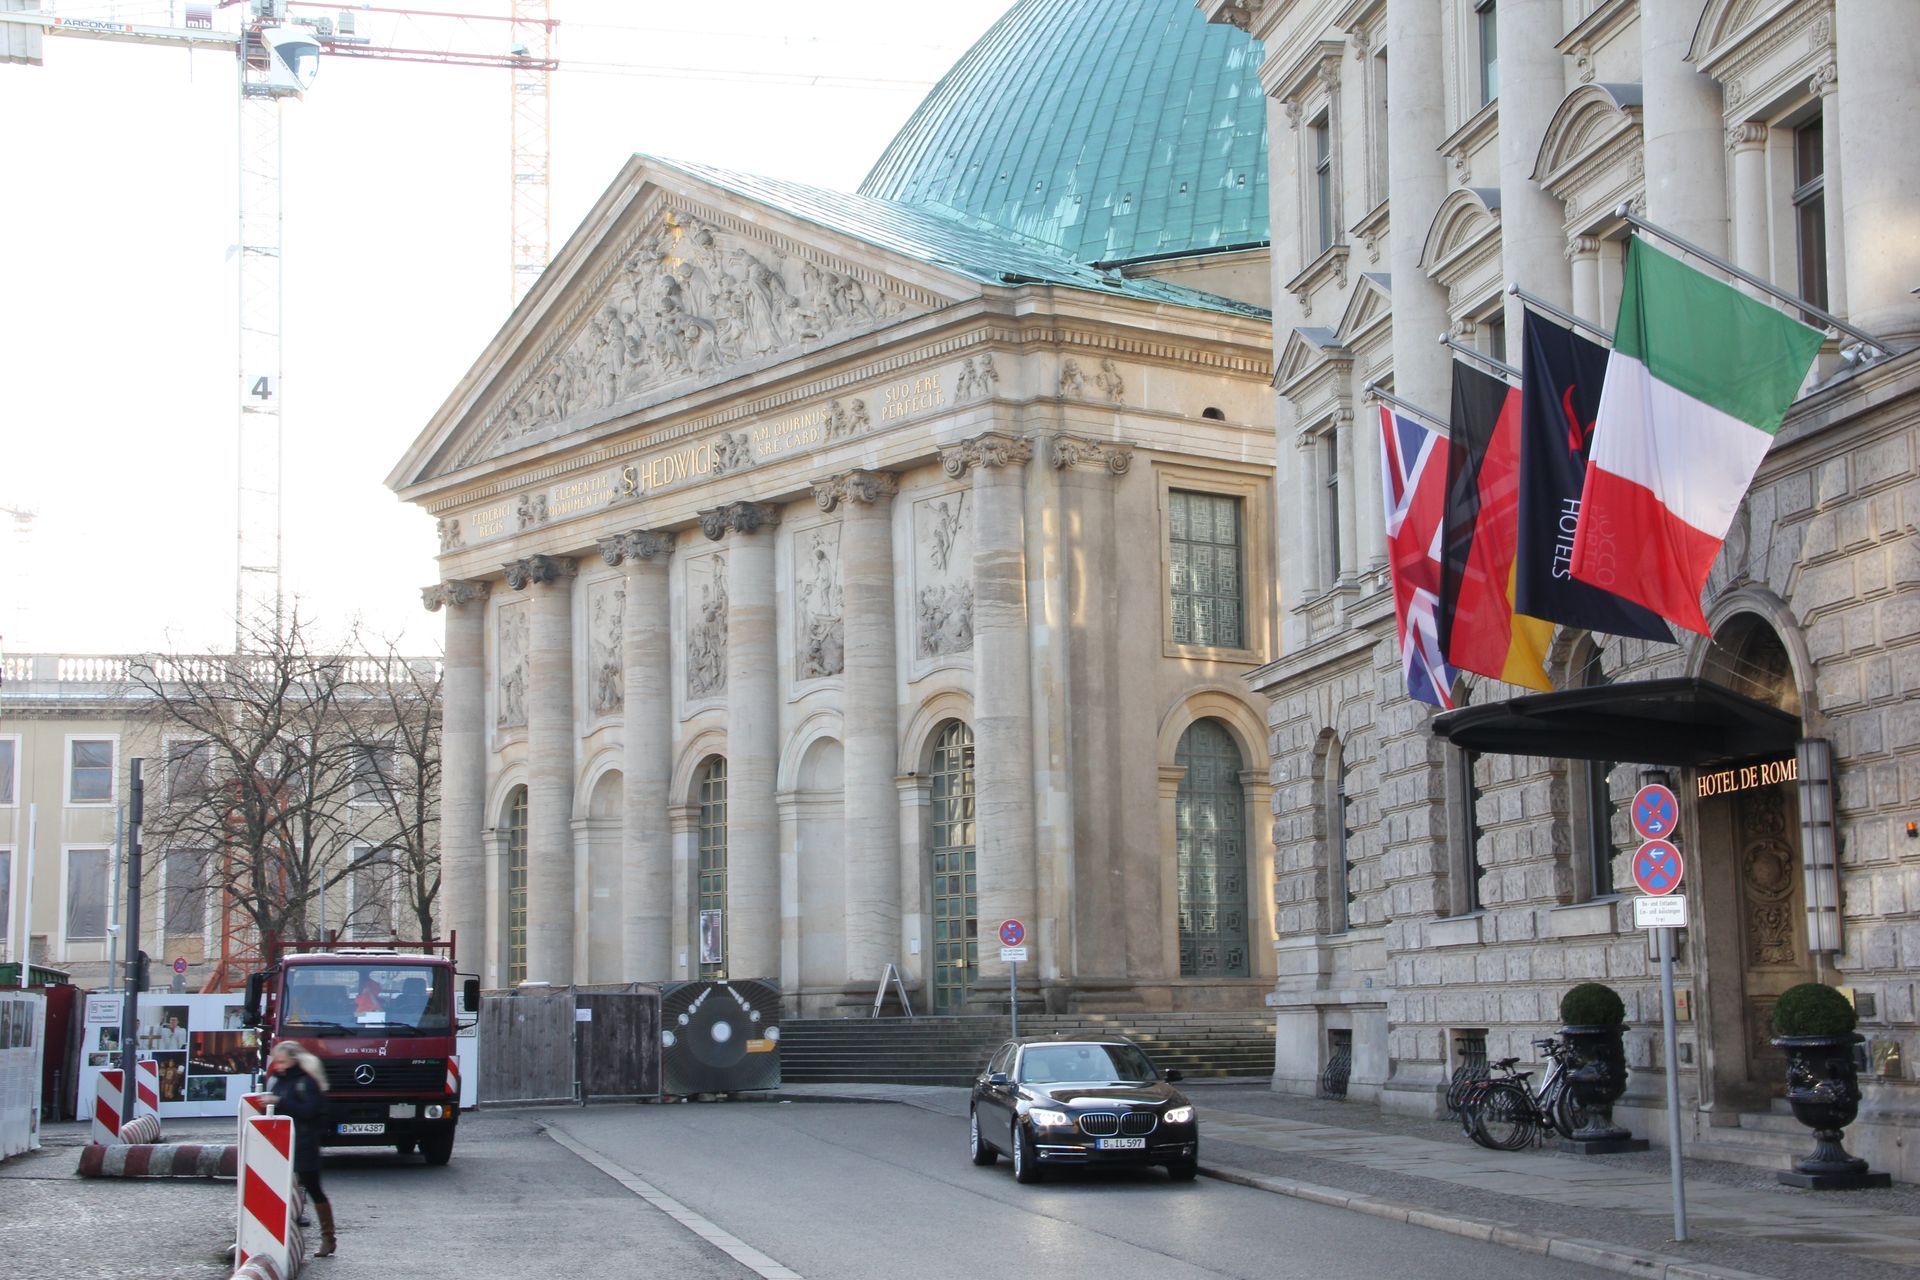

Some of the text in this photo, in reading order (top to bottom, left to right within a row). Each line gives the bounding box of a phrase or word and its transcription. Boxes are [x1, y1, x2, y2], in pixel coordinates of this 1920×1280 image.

[63, 18, 124, 31] ARCOMET
[187, 19, 211, 28] mib
[251, 376, 273, 400] 4
[885, 383, 910, 404] SUO
[774, 408, 827, 437] QUIRINUS
[641, 441, 721, 490] HEDWIGIS
[548, 489, 614, 517] MONUMENTUM
[472, 504, 511, 527] FEDERICI
[479, 520, 504, 538] REGIS
[1697, 770, 1739, 798] HOTEL
[1740, 766, 1759, 789] DE
[1127, 1139, 1142, 1148] 597
